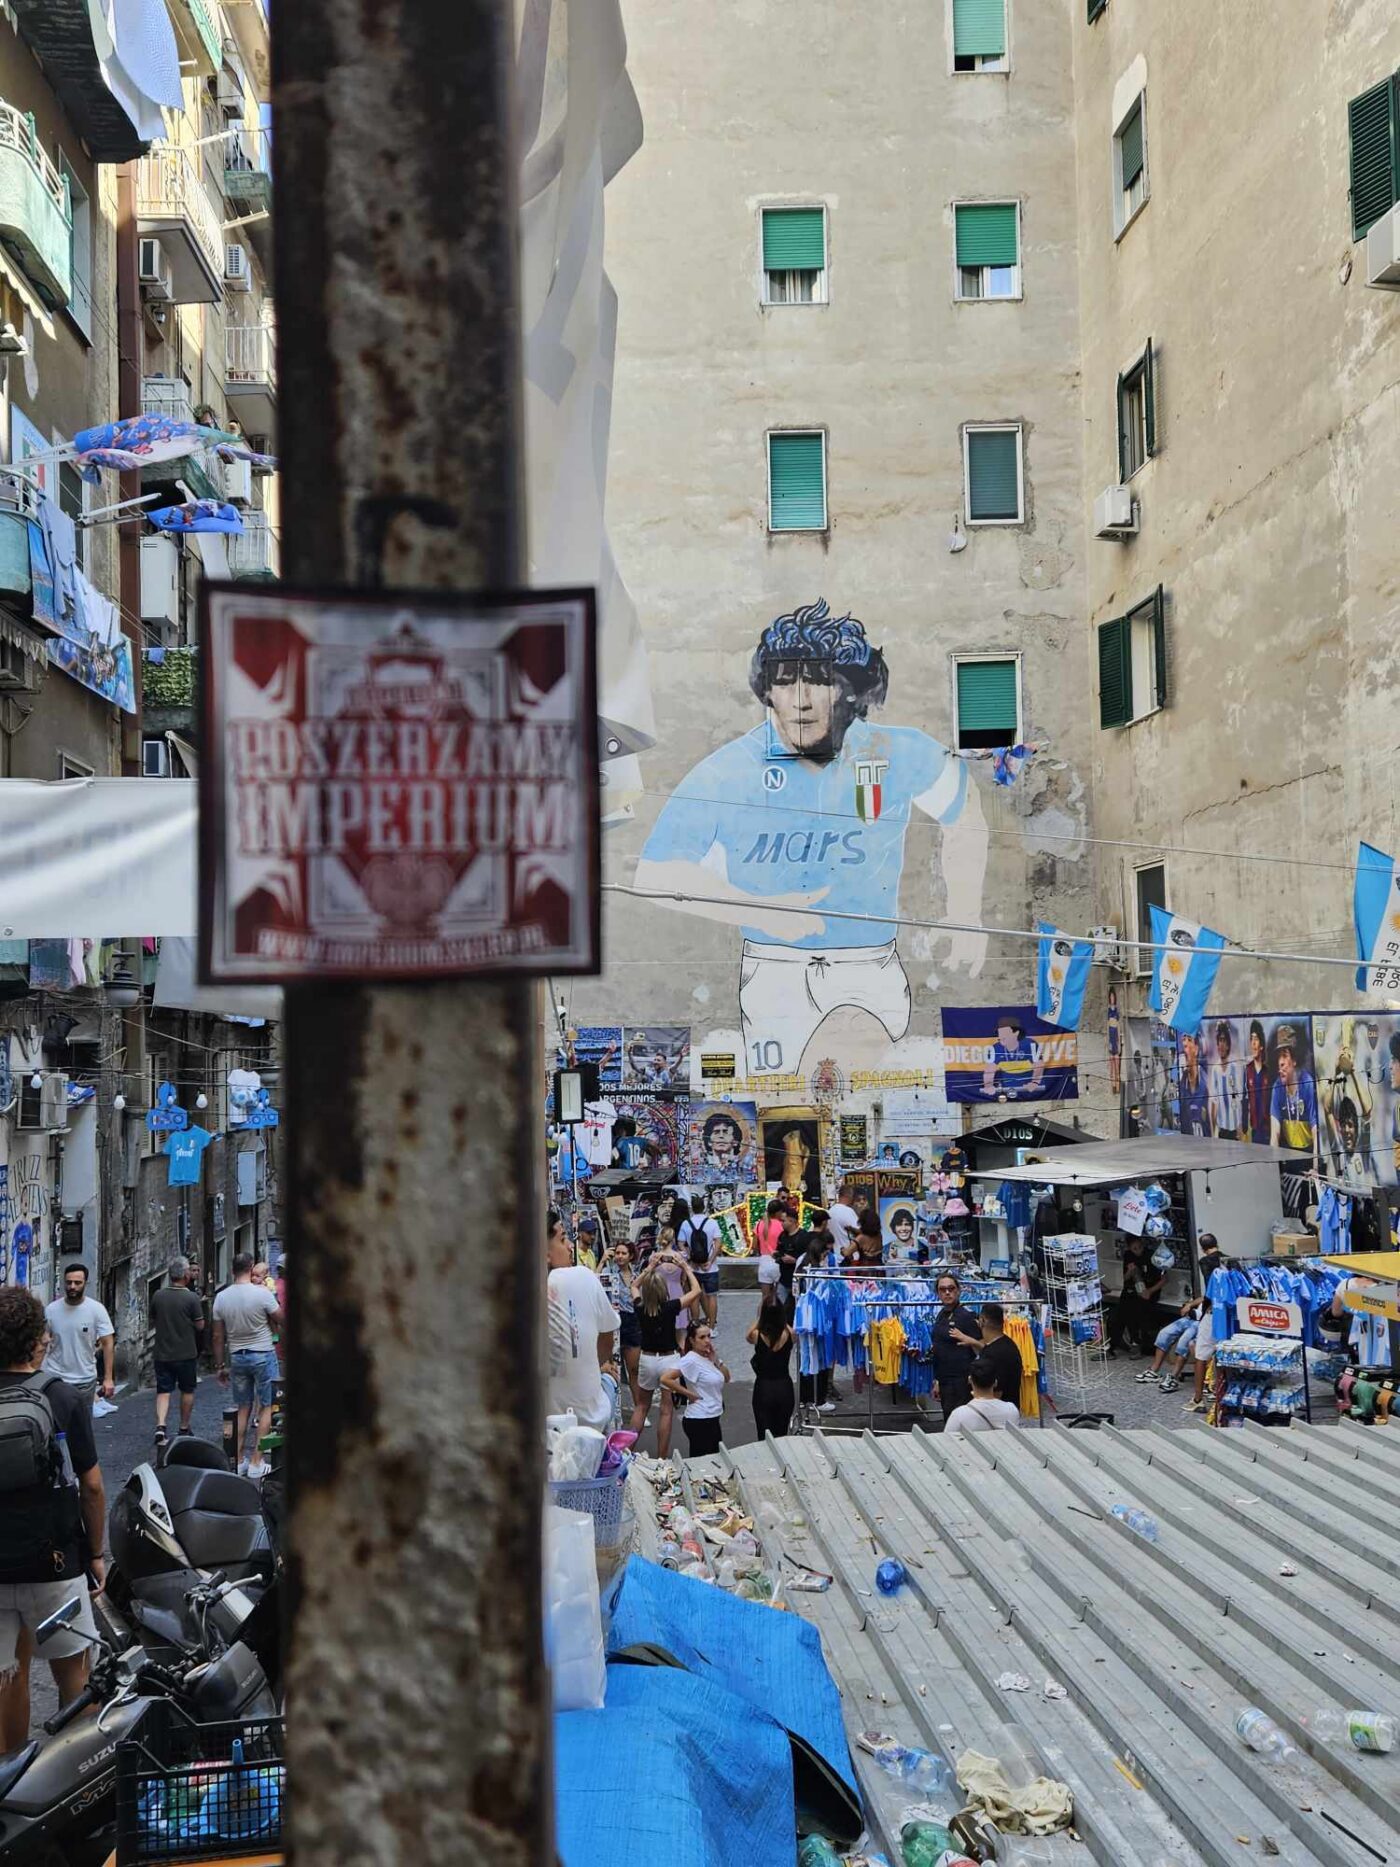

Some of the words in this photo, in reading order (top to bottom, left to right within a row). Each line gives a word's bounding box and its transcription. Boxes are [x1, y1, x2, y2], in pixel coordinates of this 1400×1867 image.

[233, 720, 575, 780] POSZERZAMY
[766, 770, 782, 788] N
[235, 780, 575, 856] IMPERIUM
[742, 830, 867, 865] Mars
[751, 1040, 783, 1071] 10
[943, 1045, 996, 1064] DIEGO
[1030, 1040, 1077, 1063] VIVE
[1250, 1306, 1289, 1321] AMICA
[78, 1739, 117, 1774] SUZU
